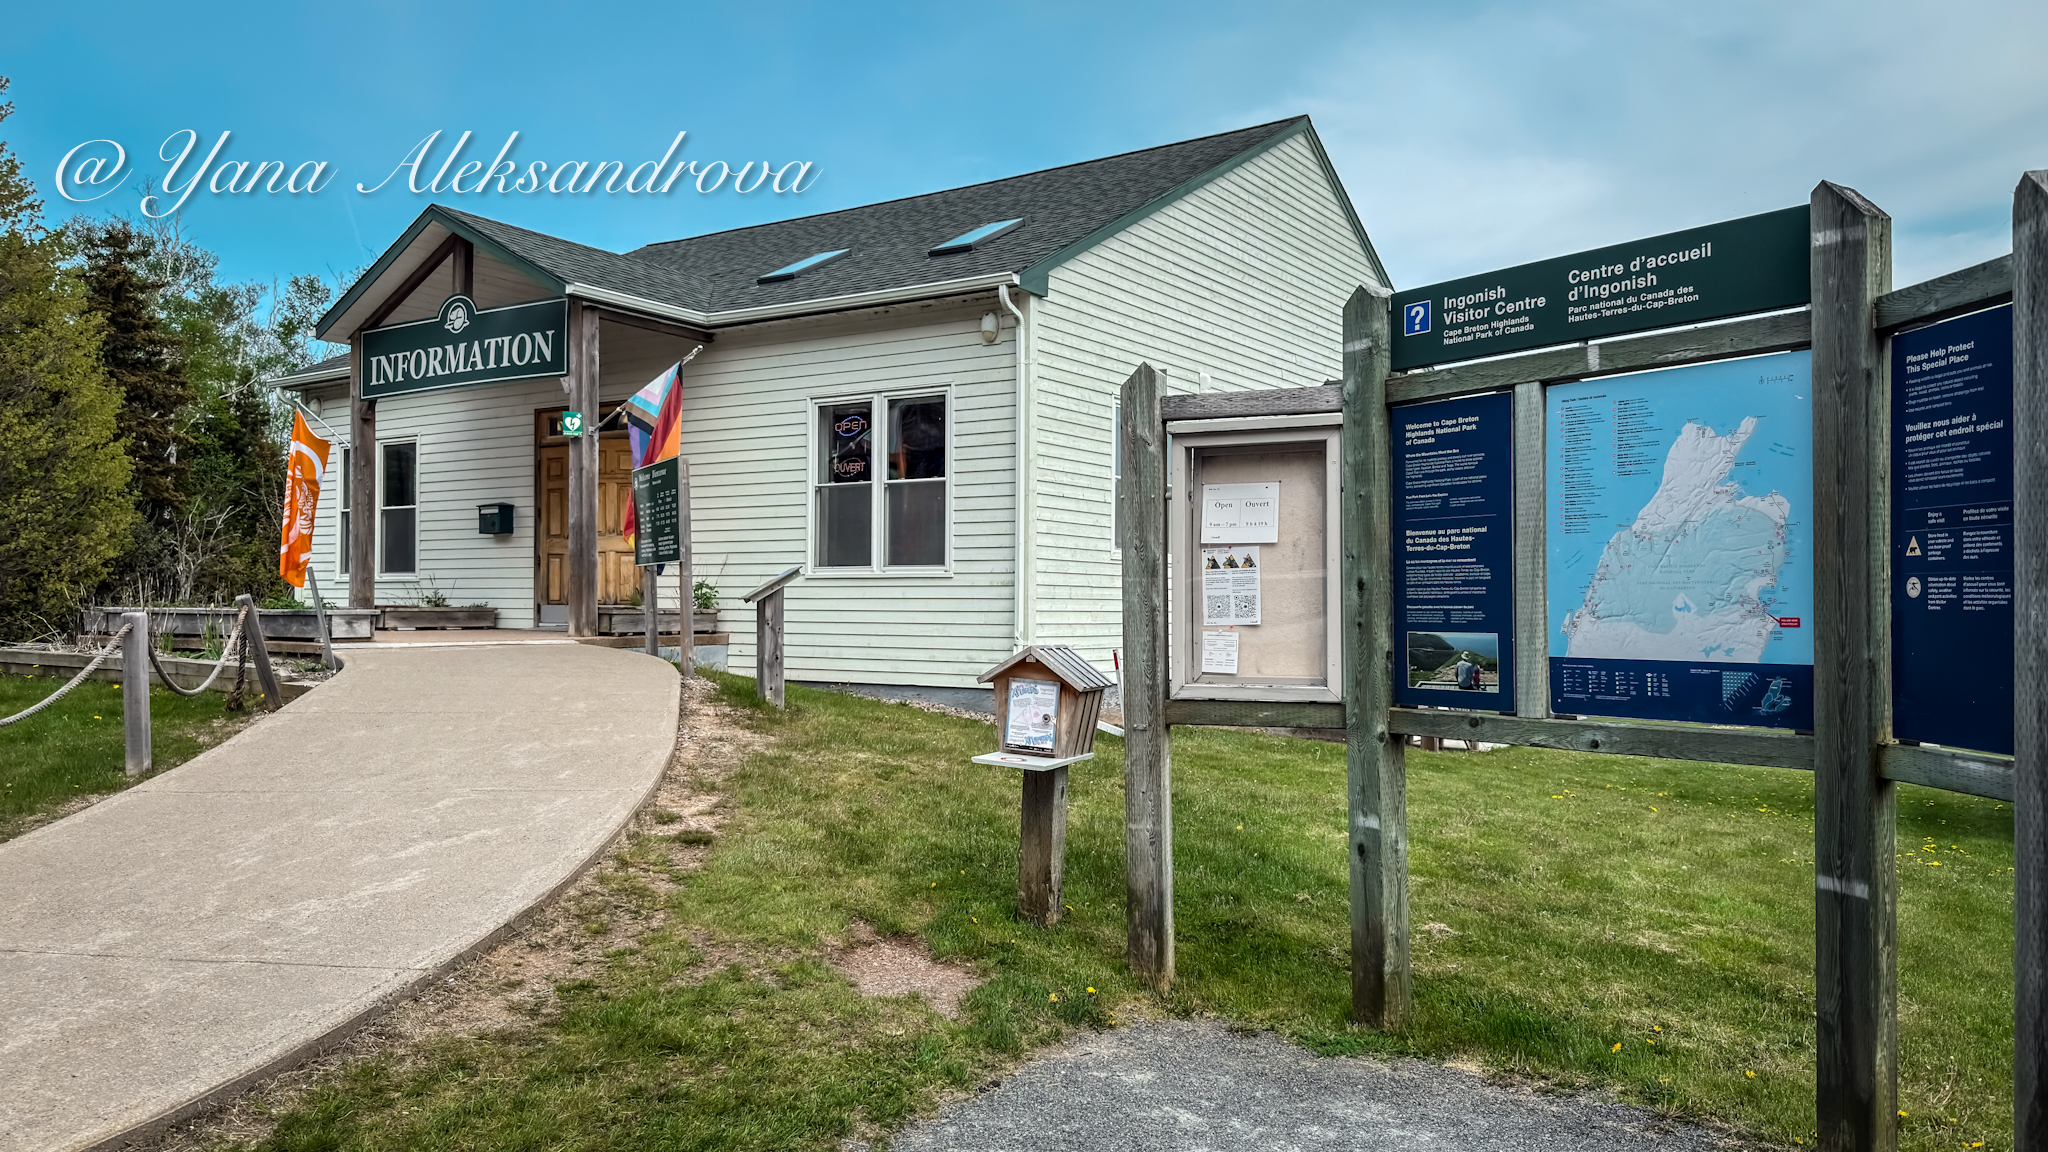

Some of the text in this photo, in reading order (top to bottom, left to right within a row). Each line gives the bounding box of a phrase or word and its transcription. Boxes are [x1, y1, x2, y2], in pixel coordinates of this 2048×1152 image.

[1568, 264, 1624, 284] Centre
[1444, 286, 1506, 309] Ingonish
[1568, 285, 1694, 314] Parc national du Canada des
[1443, 296, 1546, 325] Visitor Centre
[1568, 294, 1699, 323] Hautes-Terres-du-Cap-Breton
[1443, 316, 1529, 338] Cape Breton Highlands
[1443, 323, 1534, 345] National Park of Canada
[370, 330, 555, 386] INFORMATION
[1906, 341, 1975, 363] Please Help Protect
[1906, 354, 1969, 374] This Special Place
[835, 420, 867, 432] OPEN
[1405, 429, 1434, 438] Highlands
[1436, 426, 1460, 434] National
[1905, 413, 1976, 432] Veuillez nous aider à
[1906, 420, 2003, 444] protéger cet endroit spécial
[1413, 437, 1435, 445] Canada
[834, 462, 866, 473] OUVERT
[1214, 501, 1232, 510] Open
[1415, 536, 1437, 544] Canada
[1462, 526, 1487, 534] national
